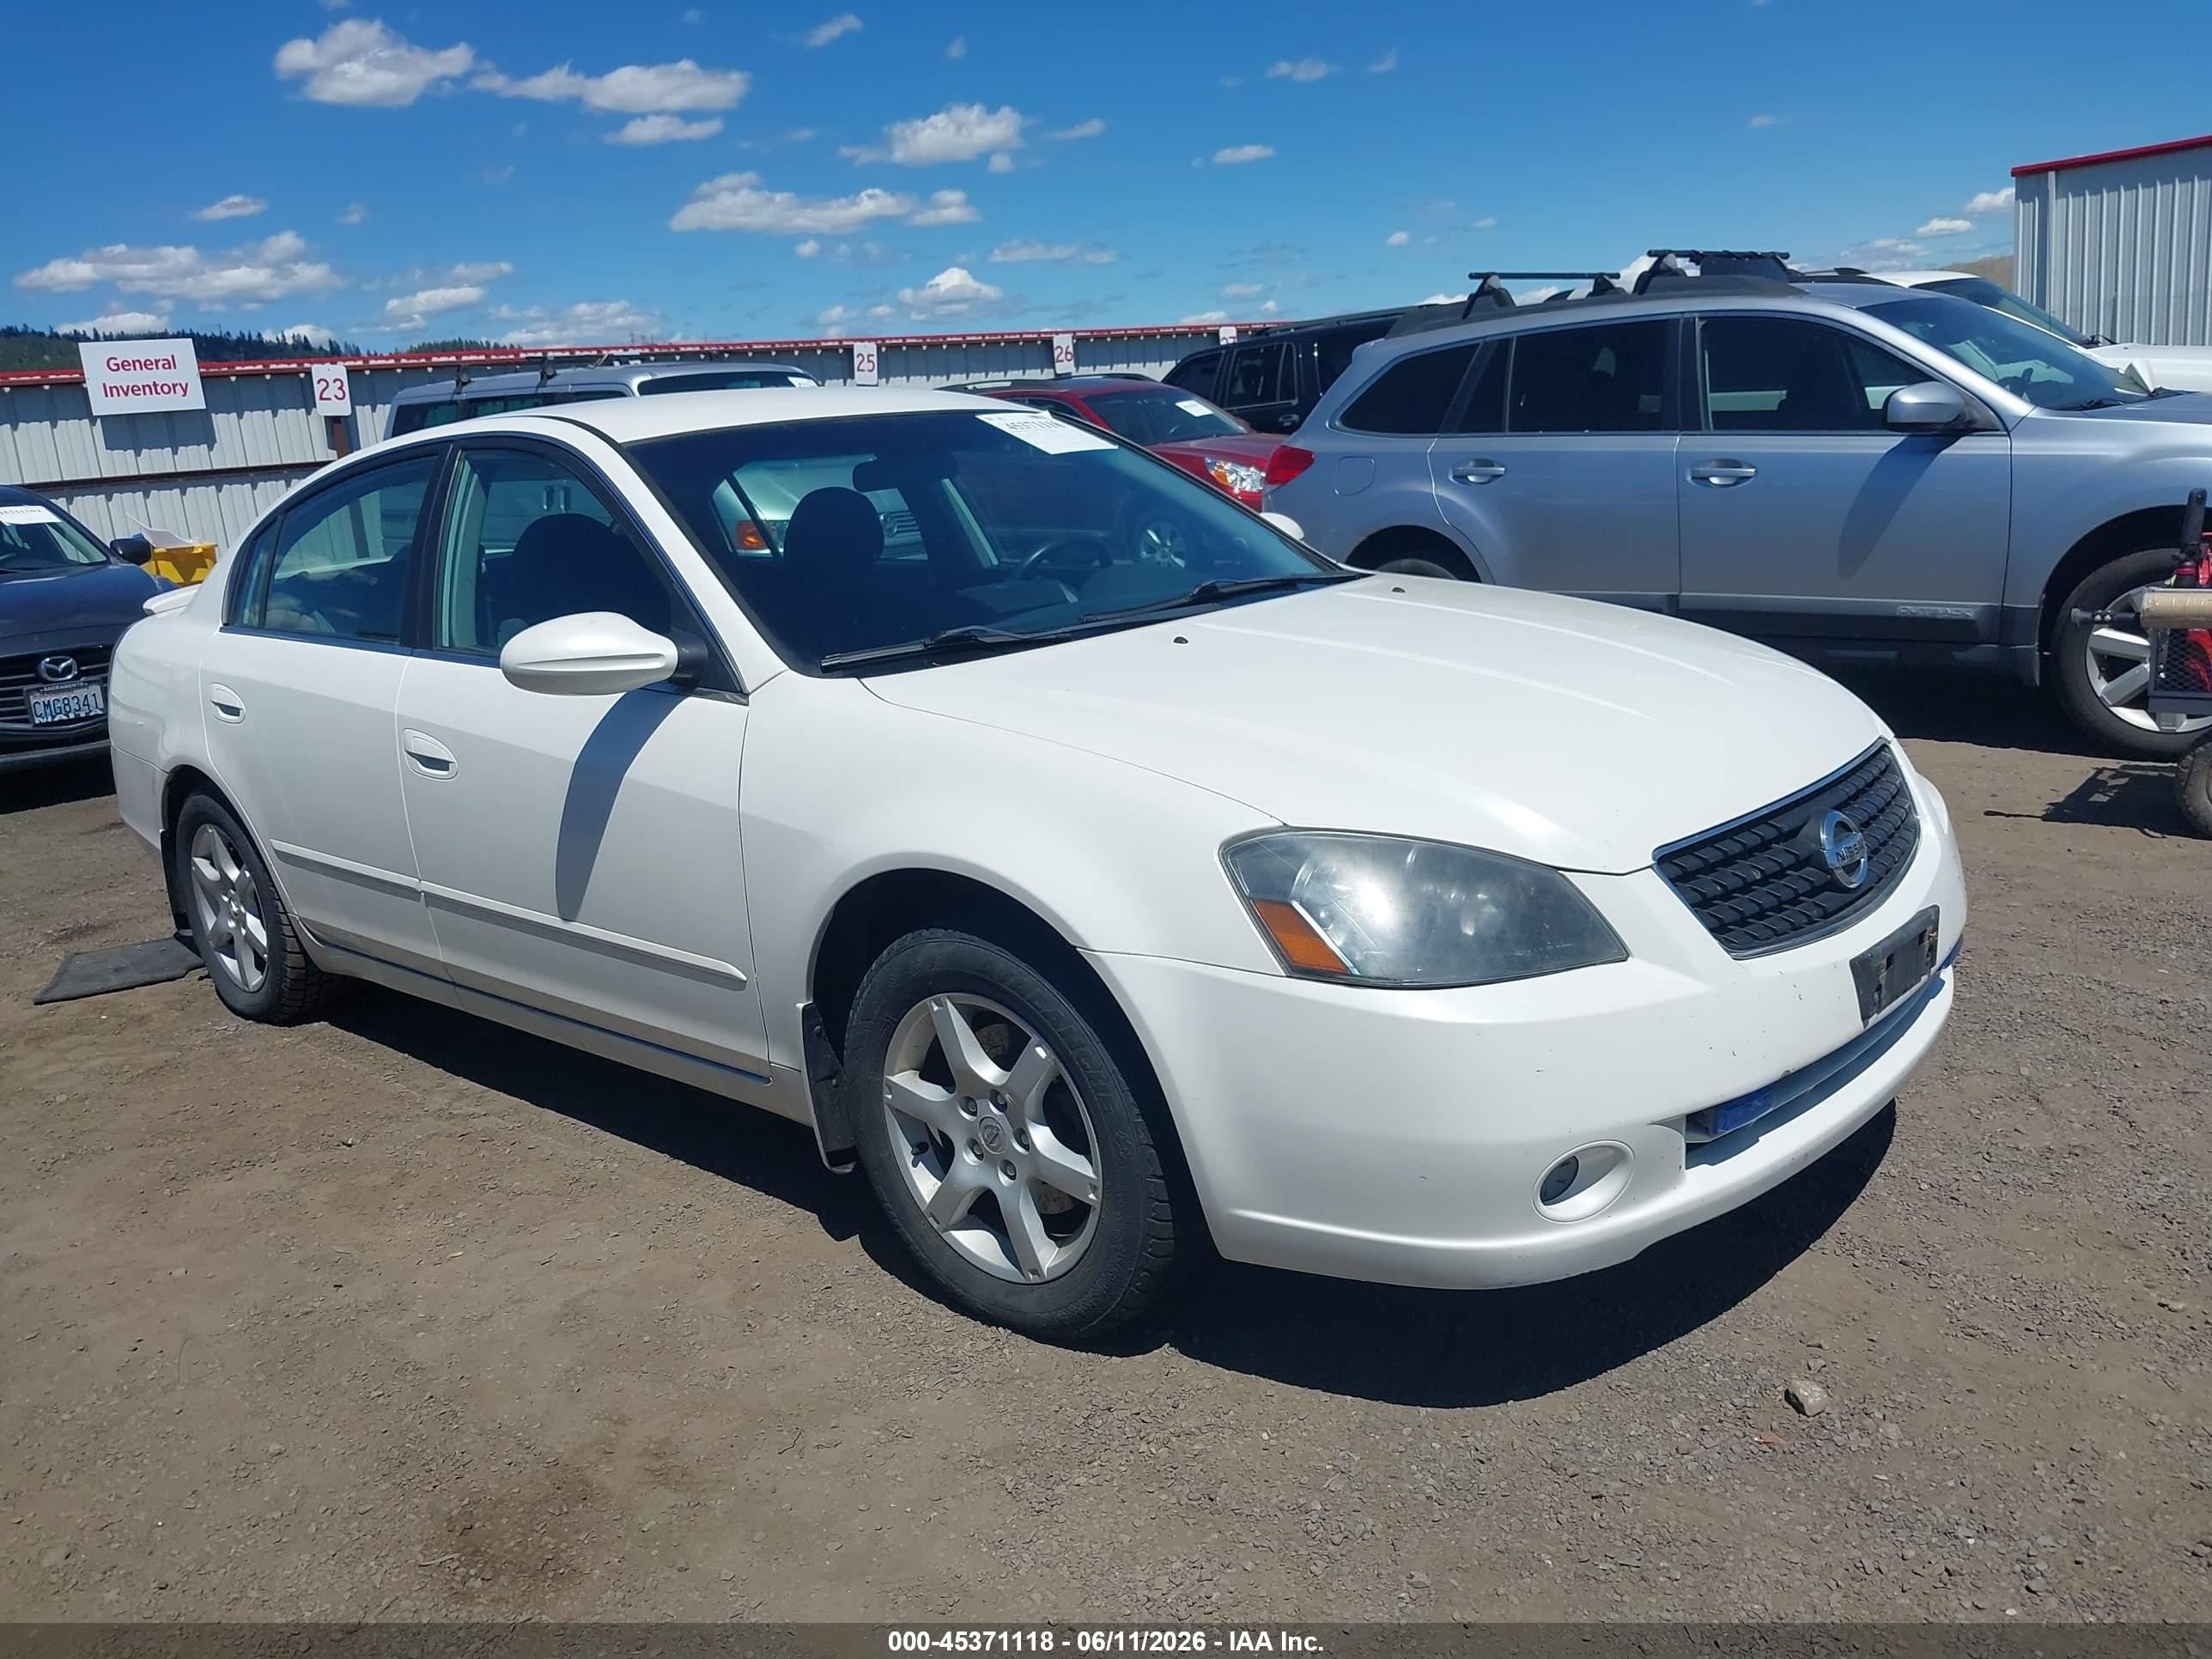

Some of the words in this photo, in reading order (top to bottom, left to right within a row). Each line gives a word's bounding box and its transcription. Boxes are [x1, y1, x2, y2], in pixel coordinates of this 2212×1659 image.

[106, 354, 177, 373] General
[856, 353, 875, 373] 25
[1054, 345, 1073, 363] 26
[102, 380, 190, 398] Inventory
[315, 378, 347, 402] 23
[43, 682, 84, 691] SACRAMENTO
[33, 691, 99, 718] CMG8341
[1835, 839, 1863, 863] NISS
